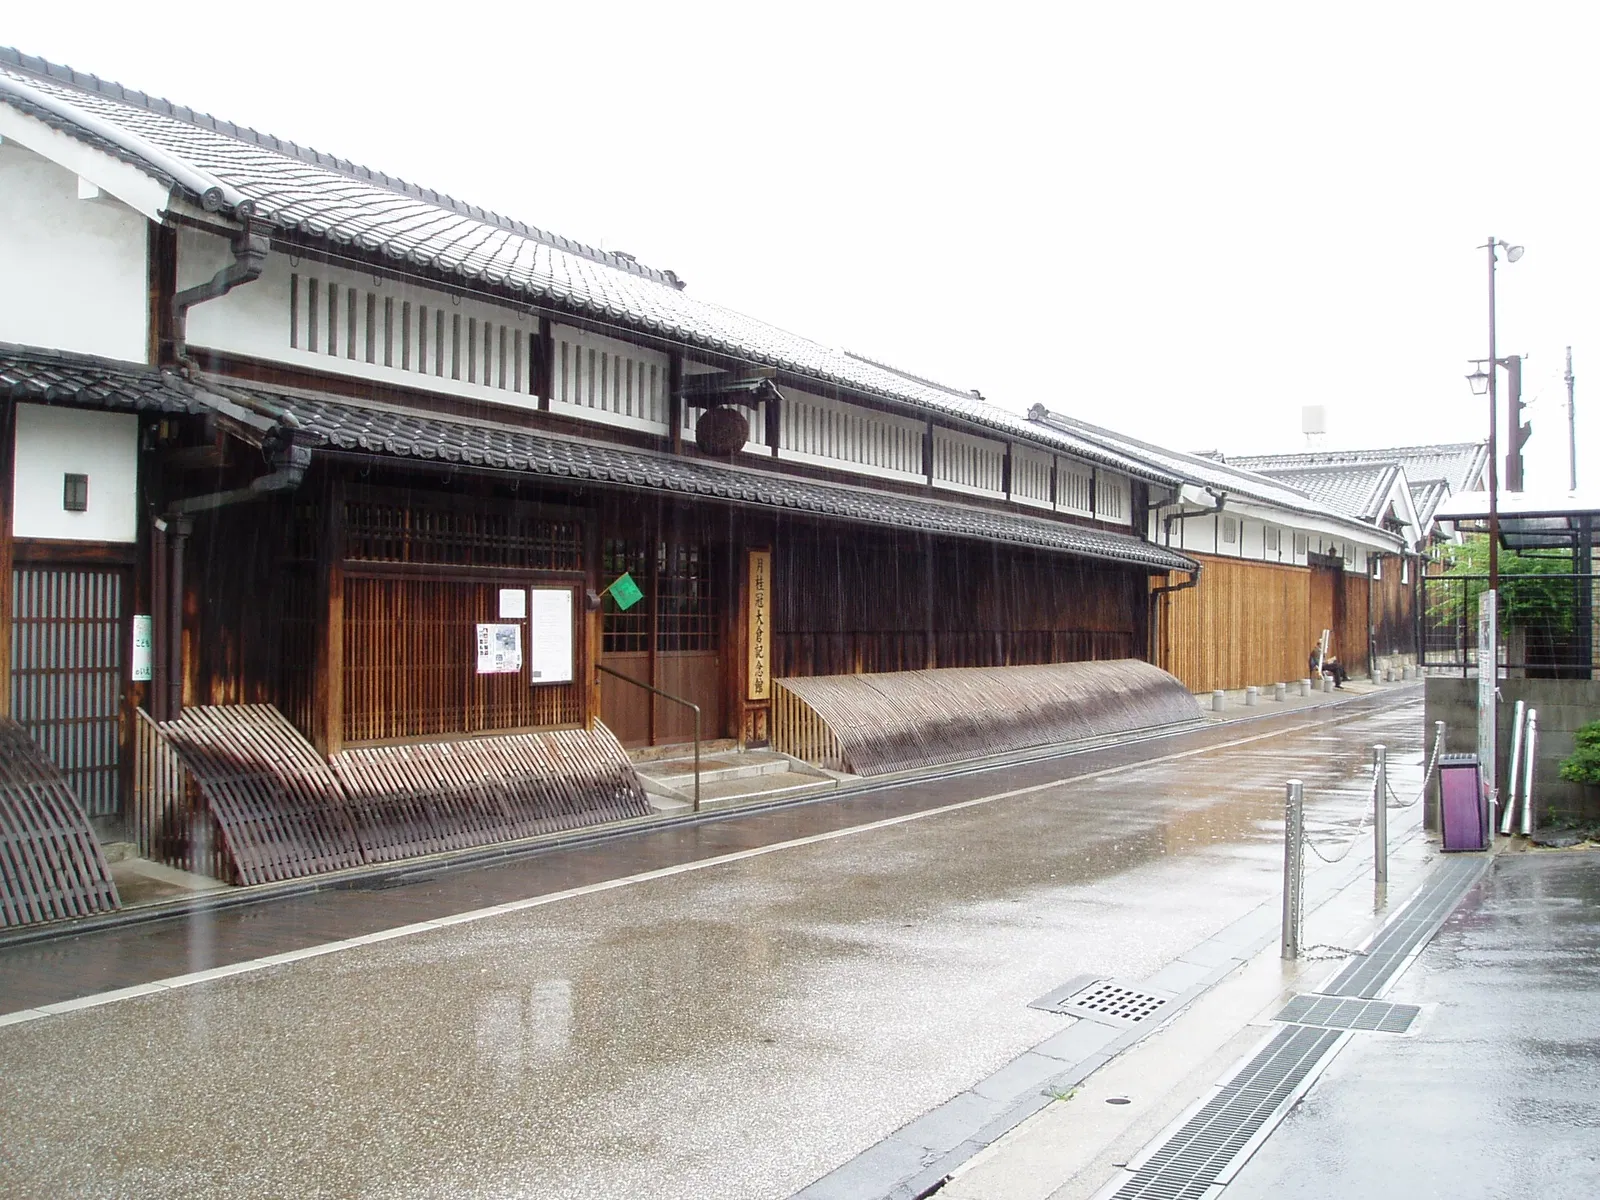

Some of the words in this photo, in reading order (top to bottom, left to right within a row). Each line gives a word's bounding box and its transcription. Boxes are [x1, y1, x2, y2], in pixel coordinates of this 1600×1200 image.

[754, 557, 765, 695] 月桂冠大倉記念館
